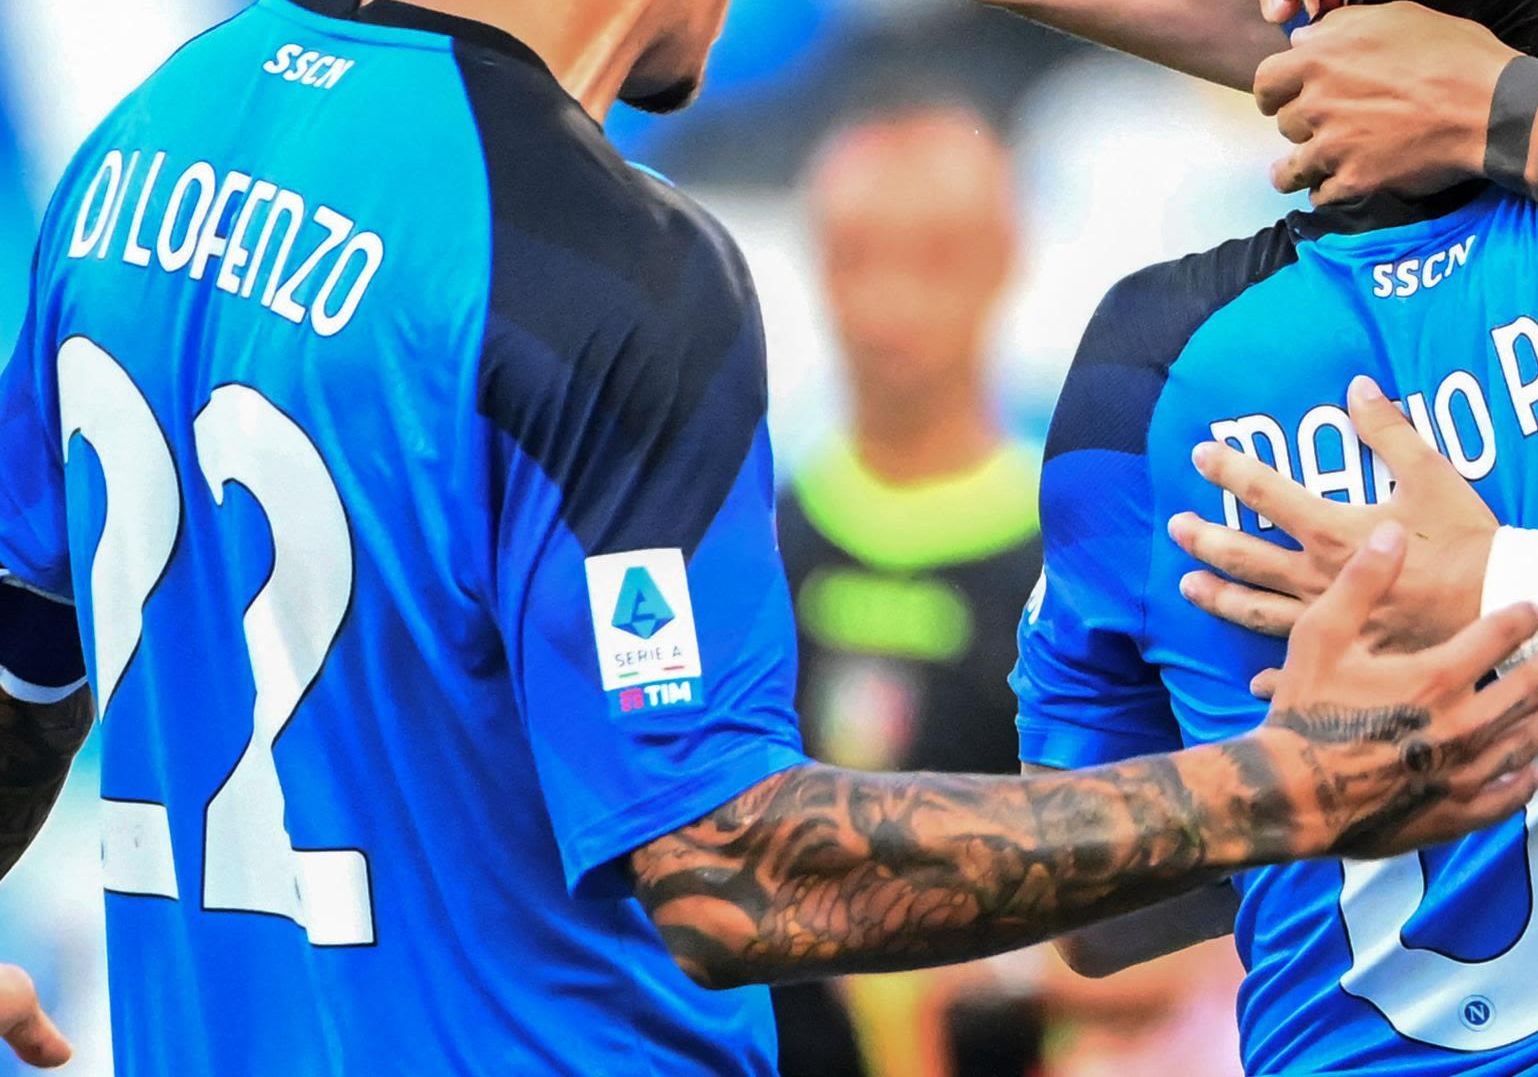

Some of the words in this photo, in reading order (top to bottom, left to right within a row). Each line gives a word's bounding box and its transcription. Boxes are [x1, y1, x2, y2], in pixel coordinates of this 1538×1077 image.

[262, 43, 355, 90] SSCN
[67, 149, 141, 260] DI
[1372, 234, 1477, 298] SSCN
[56, 334, 377, 948] 22
[615, 647, 663, 667] SERIE
[672, 645, 683, 657] A
[644, 681, 692, 706] TIM
